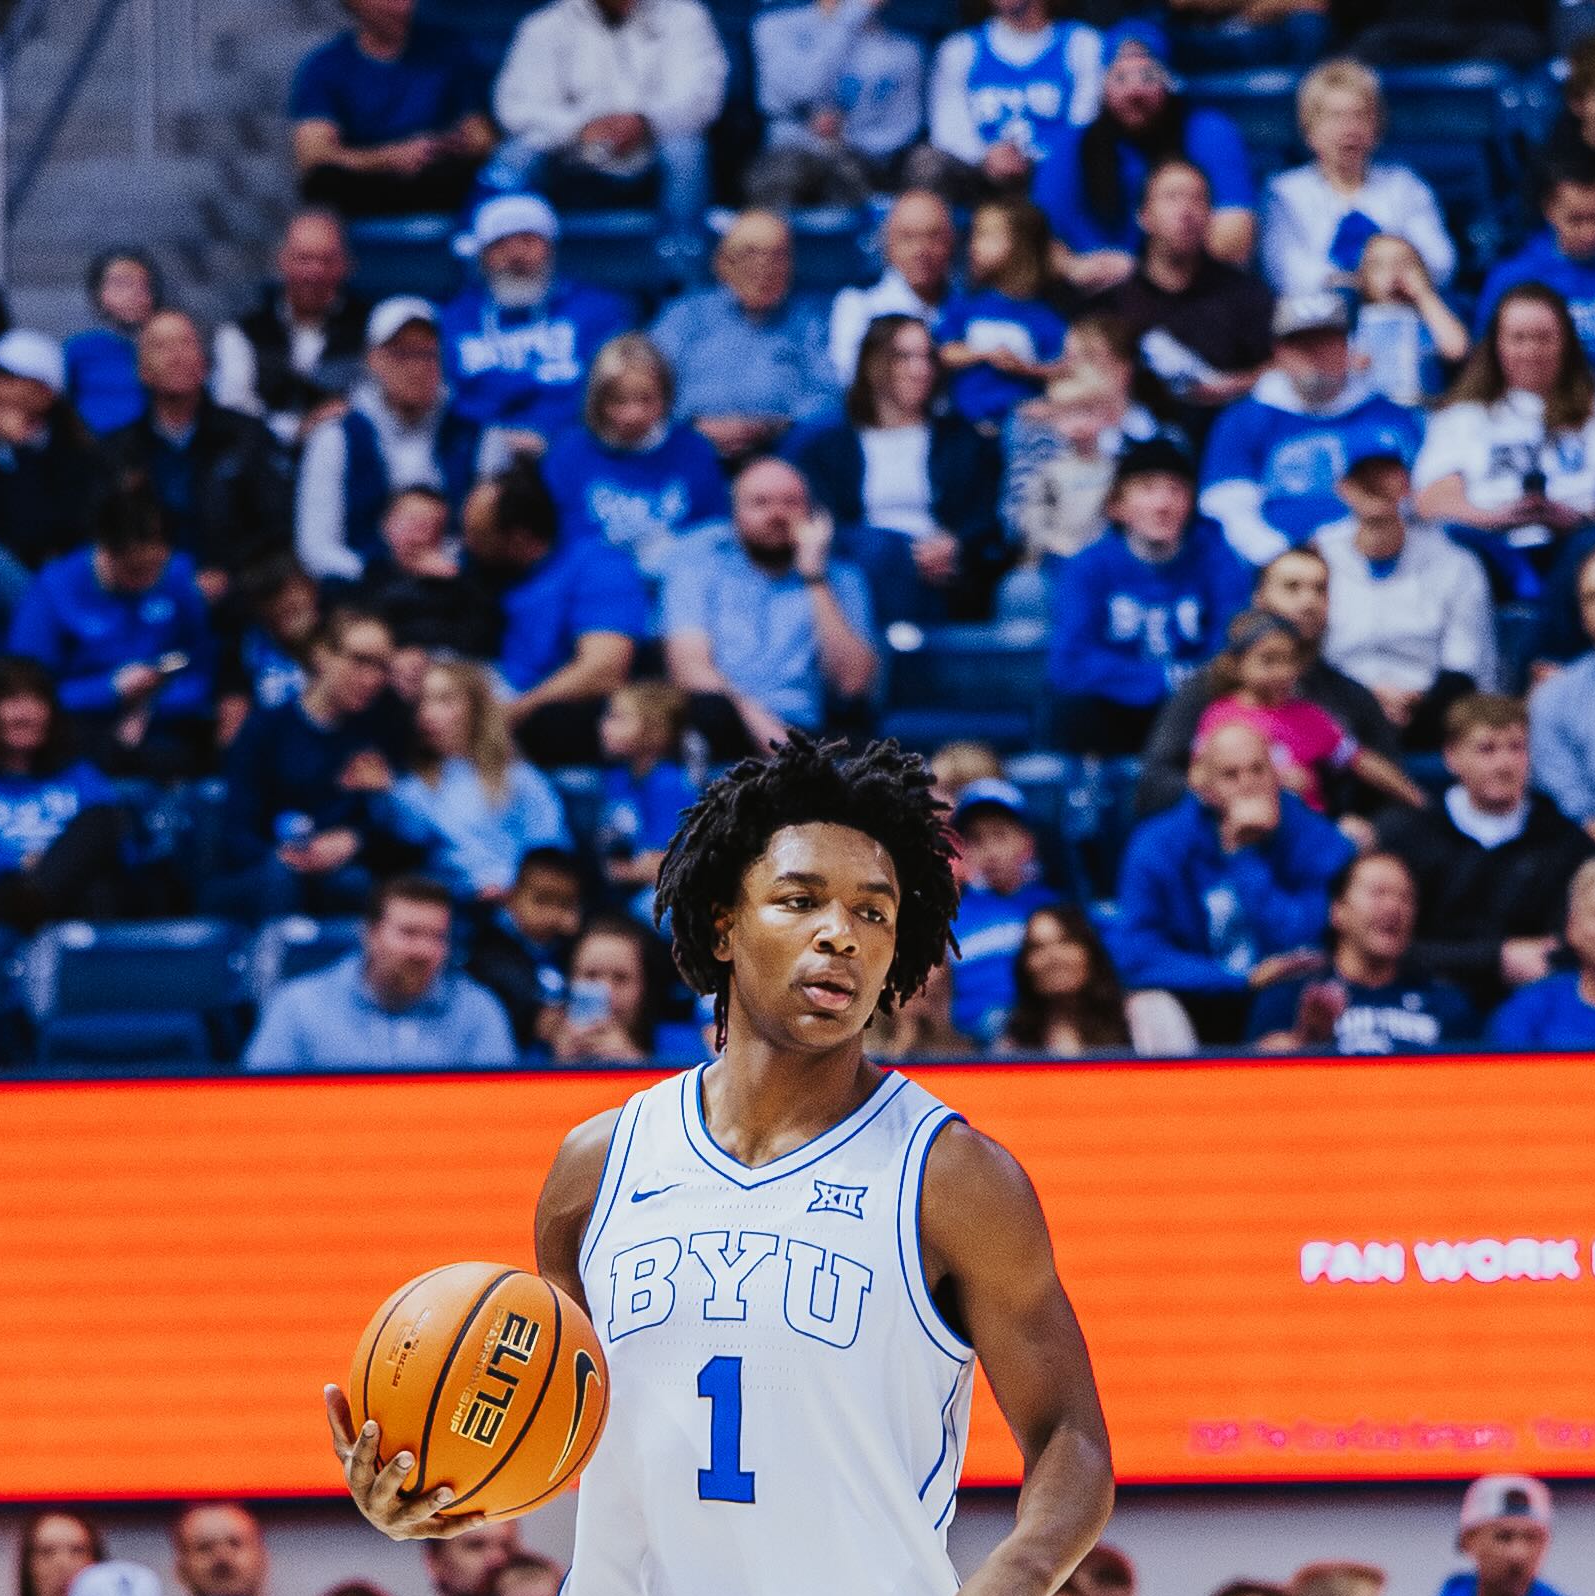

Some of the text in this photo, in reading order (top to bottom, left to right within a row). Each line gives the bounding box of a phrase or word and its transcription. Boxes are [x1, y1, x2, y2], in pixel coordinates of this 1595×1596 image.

[807, 1179, 868, 1220] XII
[607, 1229, 874, 1350] BYU
[1301, 1240, 1405, 1283] FAN
[1413, 1238, 1581, 1283] WORK
[458, 1312, 541, 1448] ELITE
[697, 1356, 756, 1504] 1
